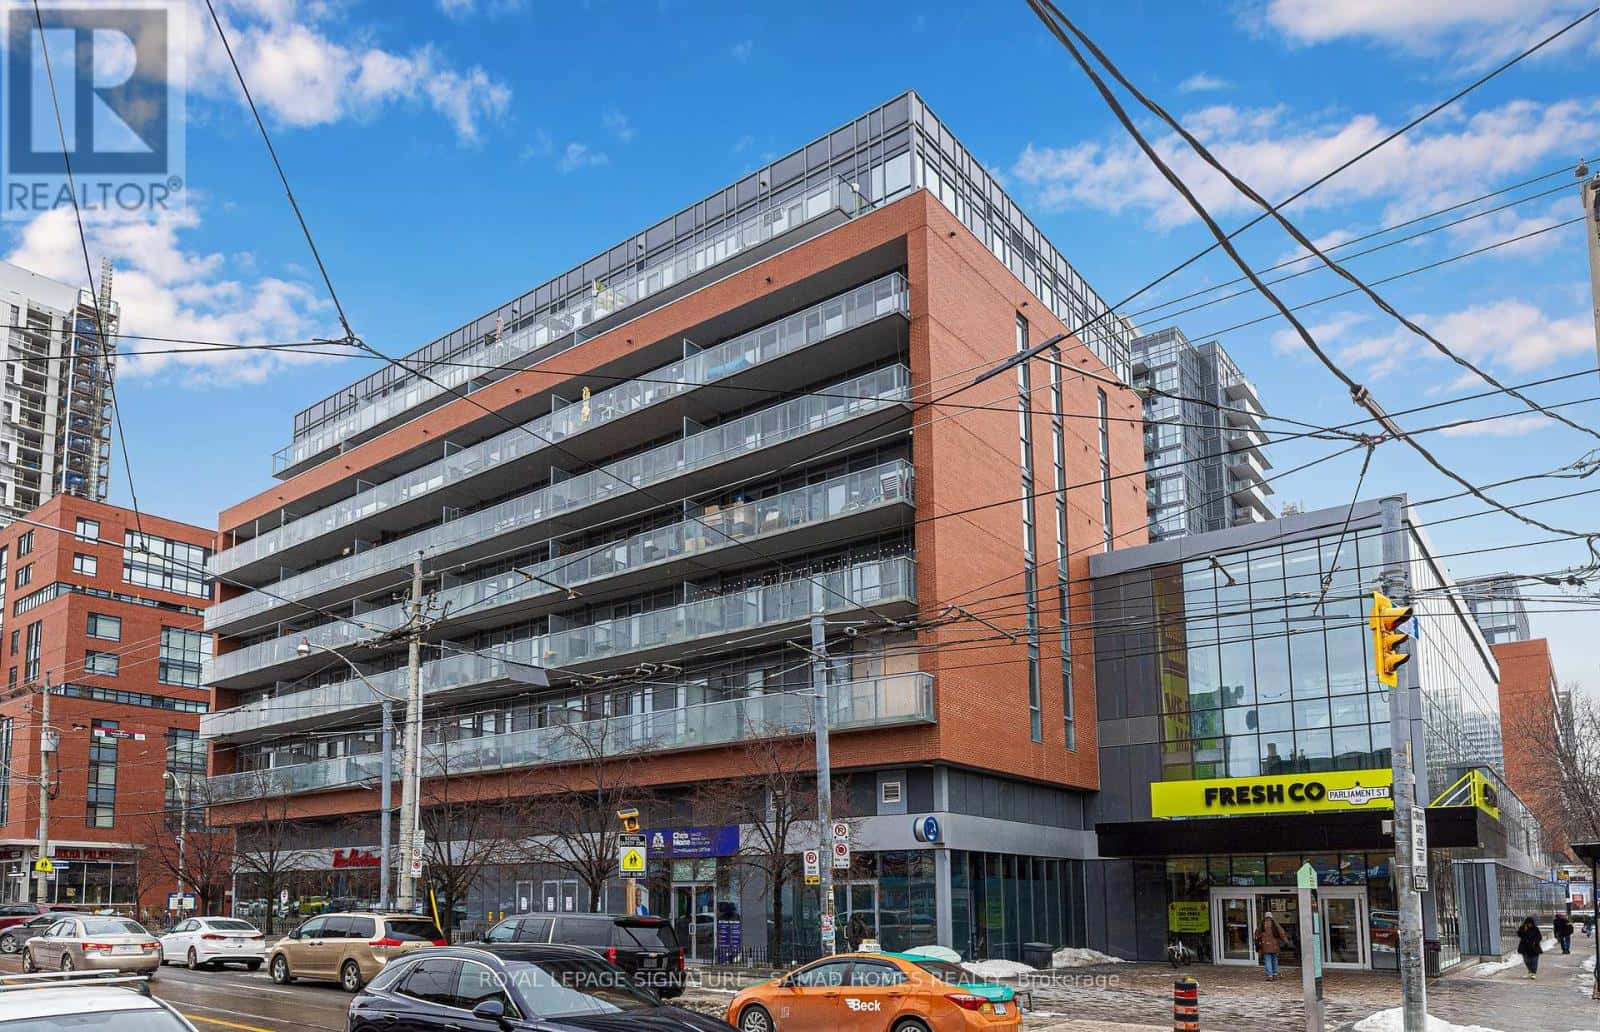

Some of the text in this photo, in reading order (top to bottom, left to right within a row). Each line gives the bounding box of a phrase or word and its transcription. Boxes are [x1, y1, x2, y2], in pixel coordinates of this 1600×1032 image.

[1205, 782, 1326, 807] FRESH CO
[1330, 788, 1386, 799] PARLIAMENT ST
[852, 999, 881, 1012] Beck
